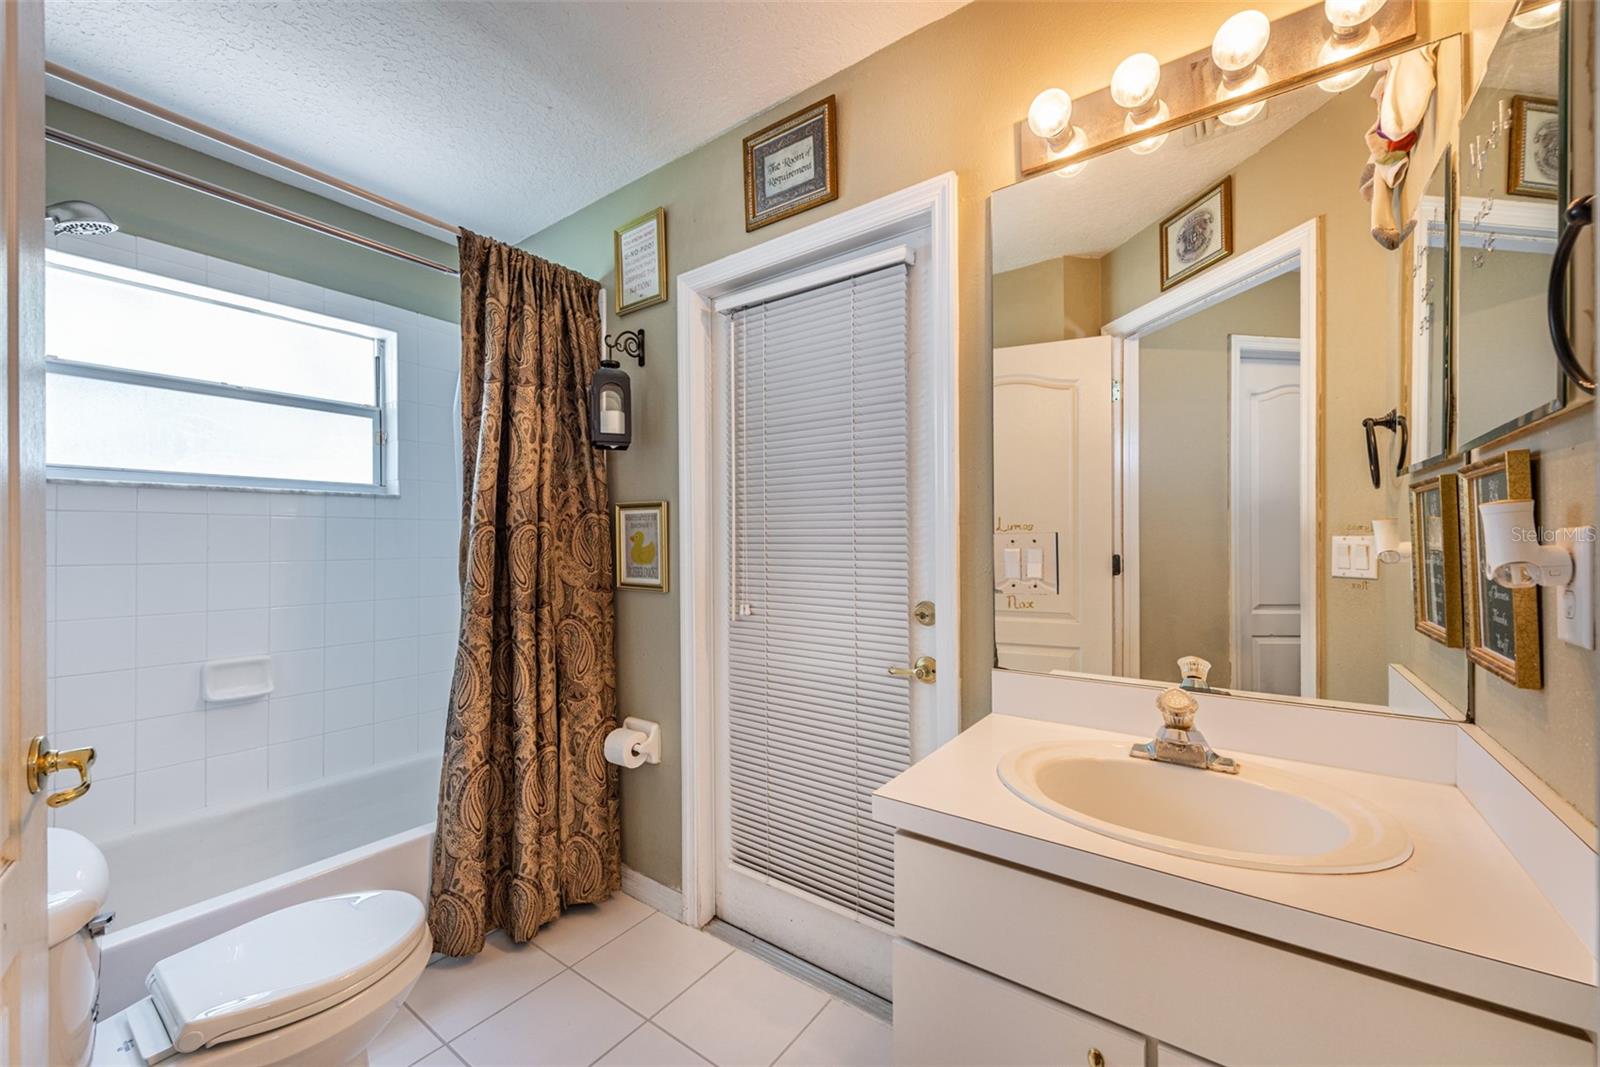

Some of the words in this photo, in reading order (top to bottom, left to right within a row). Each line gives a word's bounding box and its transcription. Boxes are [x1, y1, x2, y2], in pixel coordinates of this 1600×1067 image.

[768, 162, 781, 175] The
[782, 152, 804, 168] Room
[768, 162, 812, 187] Requirement
[996, 517, 1034, 533] Lumos
